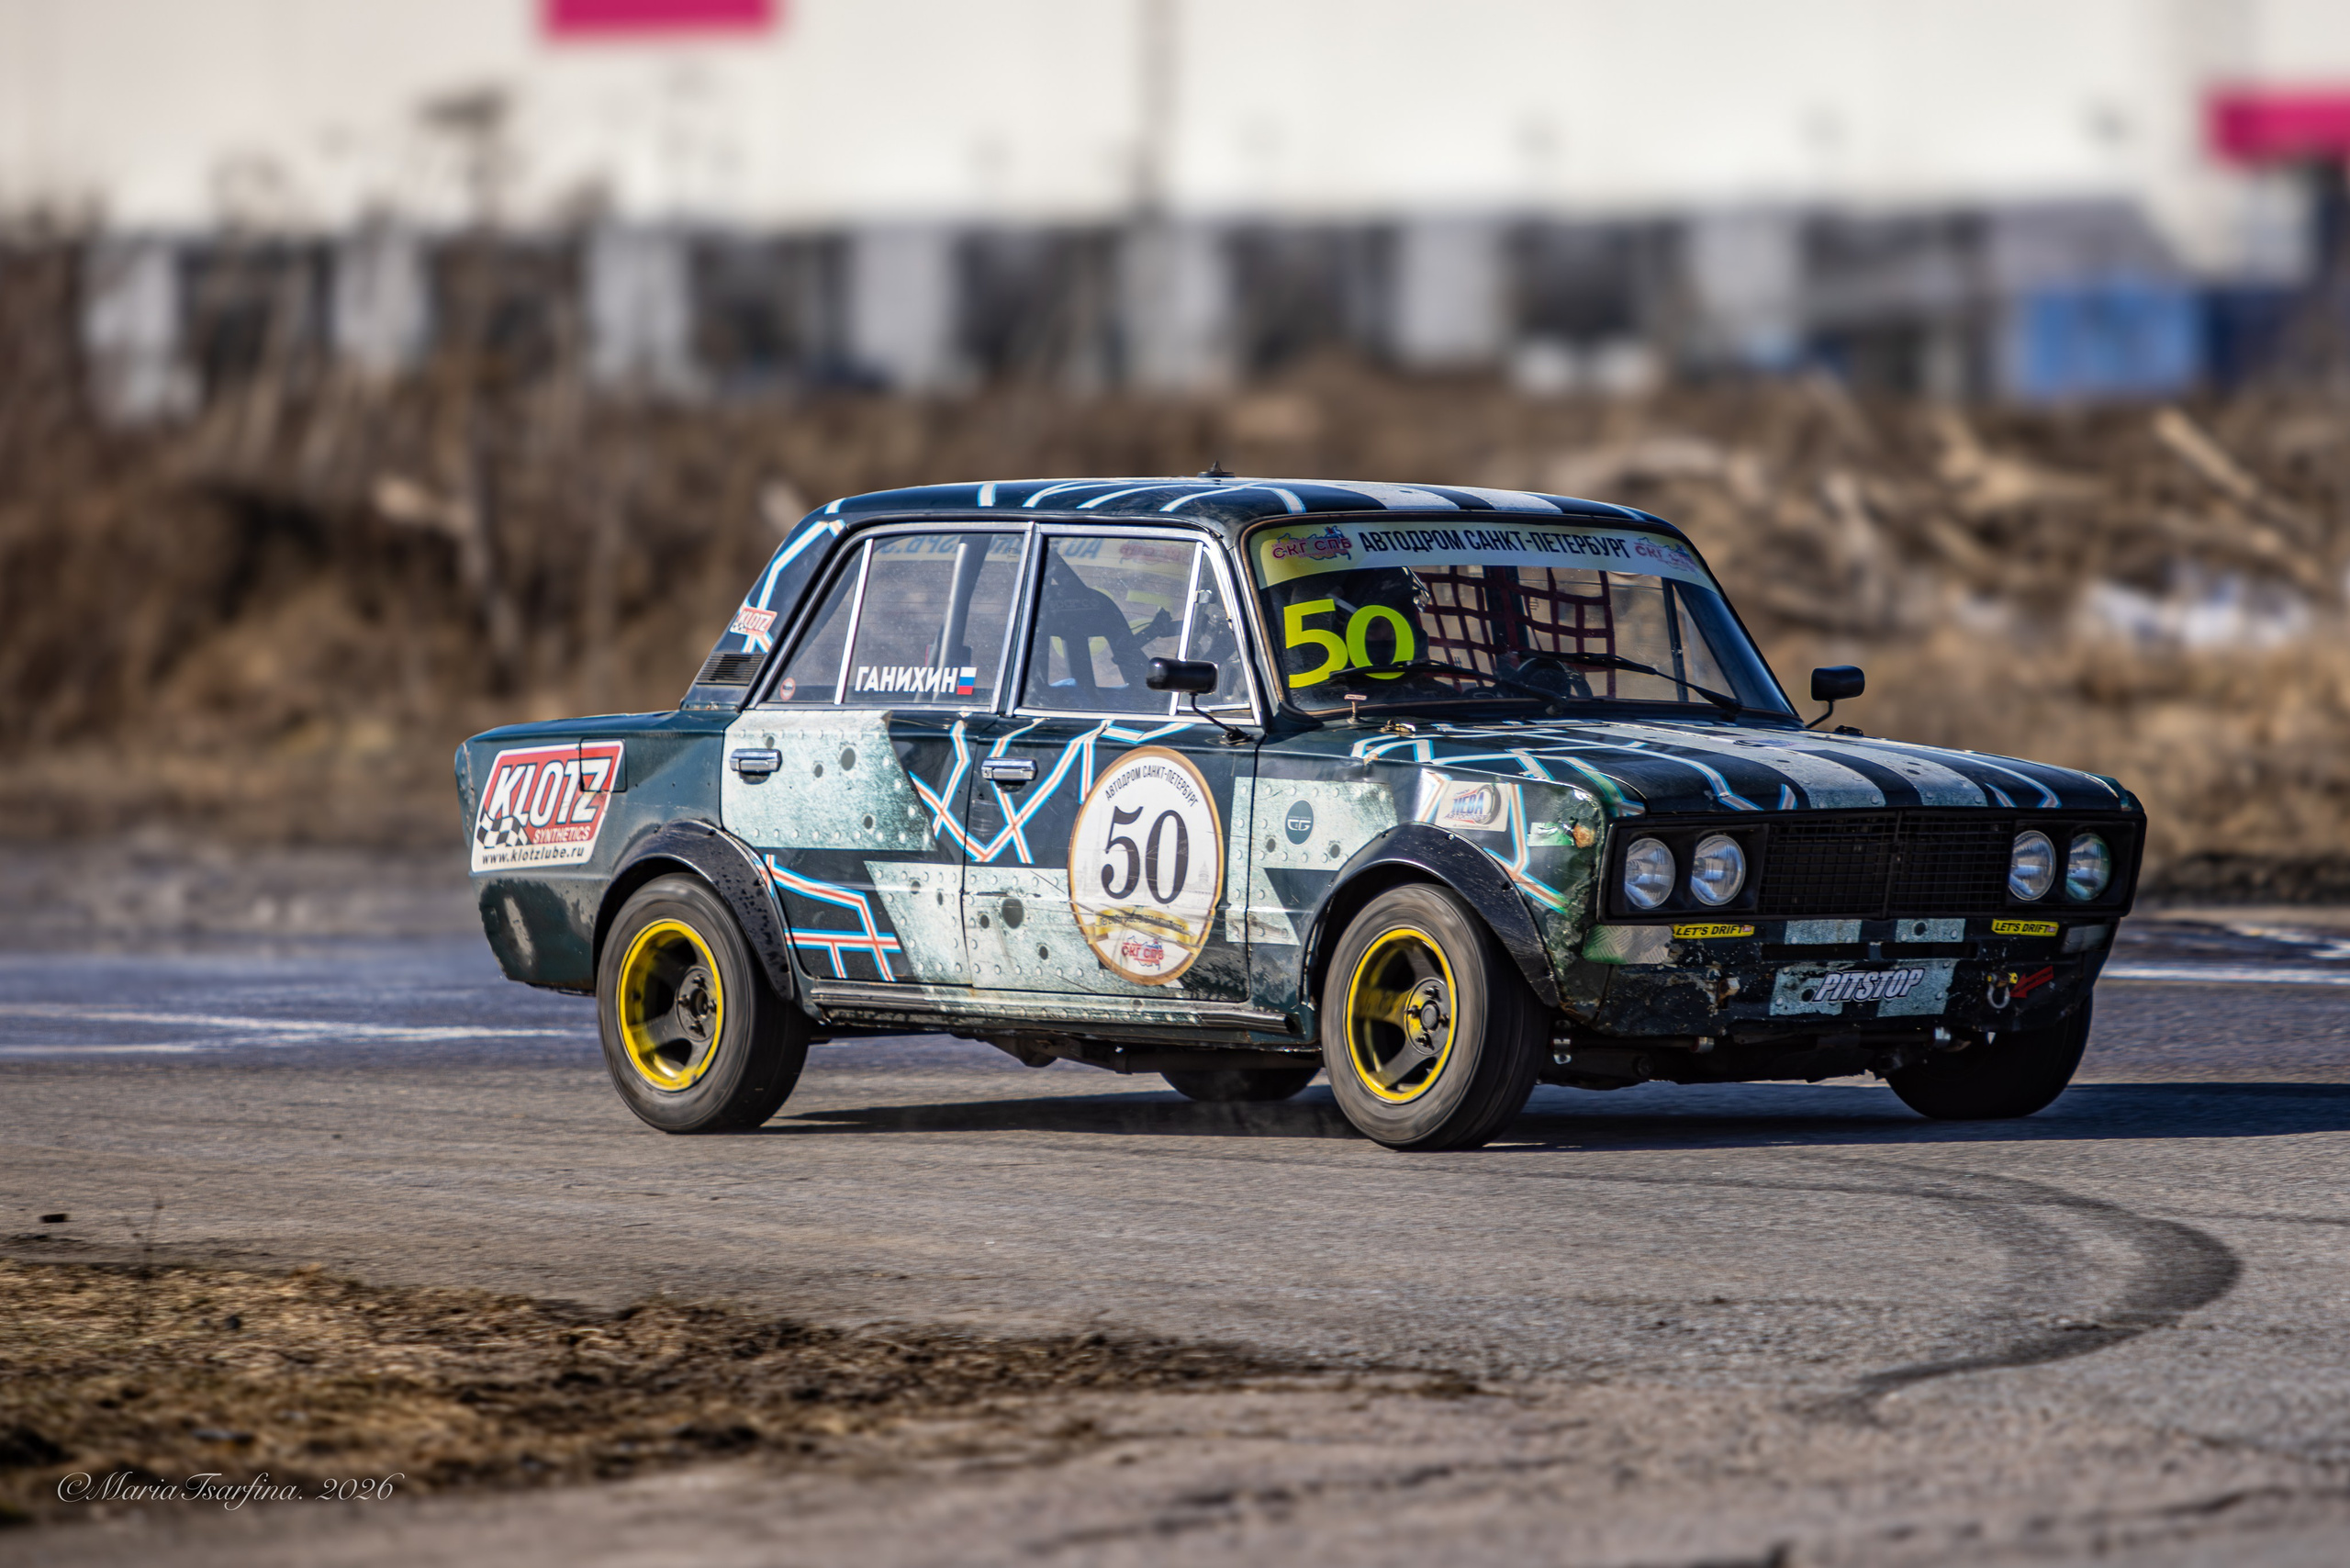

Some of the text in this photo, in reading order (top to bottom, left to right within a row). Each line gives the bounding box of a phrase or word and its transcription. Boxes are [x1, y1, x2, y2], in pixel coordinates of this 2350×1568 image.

[1272, 542, 1306, 559] СКГ
[1314, 537, 1352, 551] СПБ
[1358, 529, 1631, 558] АВТОДРОМ САНКТ-ПЕТЕРБУРГ
[738, 610, 772, 632] KLOTZ
[1283, 599, 1415, 689] 50
[855, 666, 958, 693] ГАНИХИН
[487, 756, 613, 827] KLOTZ
[1105, 765, 1199, 807] АВТОДРОМ САНКТ-ПЕТЕРБУРГ
[532, 825, 591, 844] SYNTHETICS
[482, 846, 585, 865] www.klotzlube.ru
[1101, 805, 1190, 904] 50
[1675, 926, 1709, 936] LET'S
[1710, 925, 1743, 935] DRIFT
[1995, 922, 2021, 932] LET'S
[2021, 924, 2050, 934] DRIFT
[1812, 968, 1926, 1002] PITSTOP
